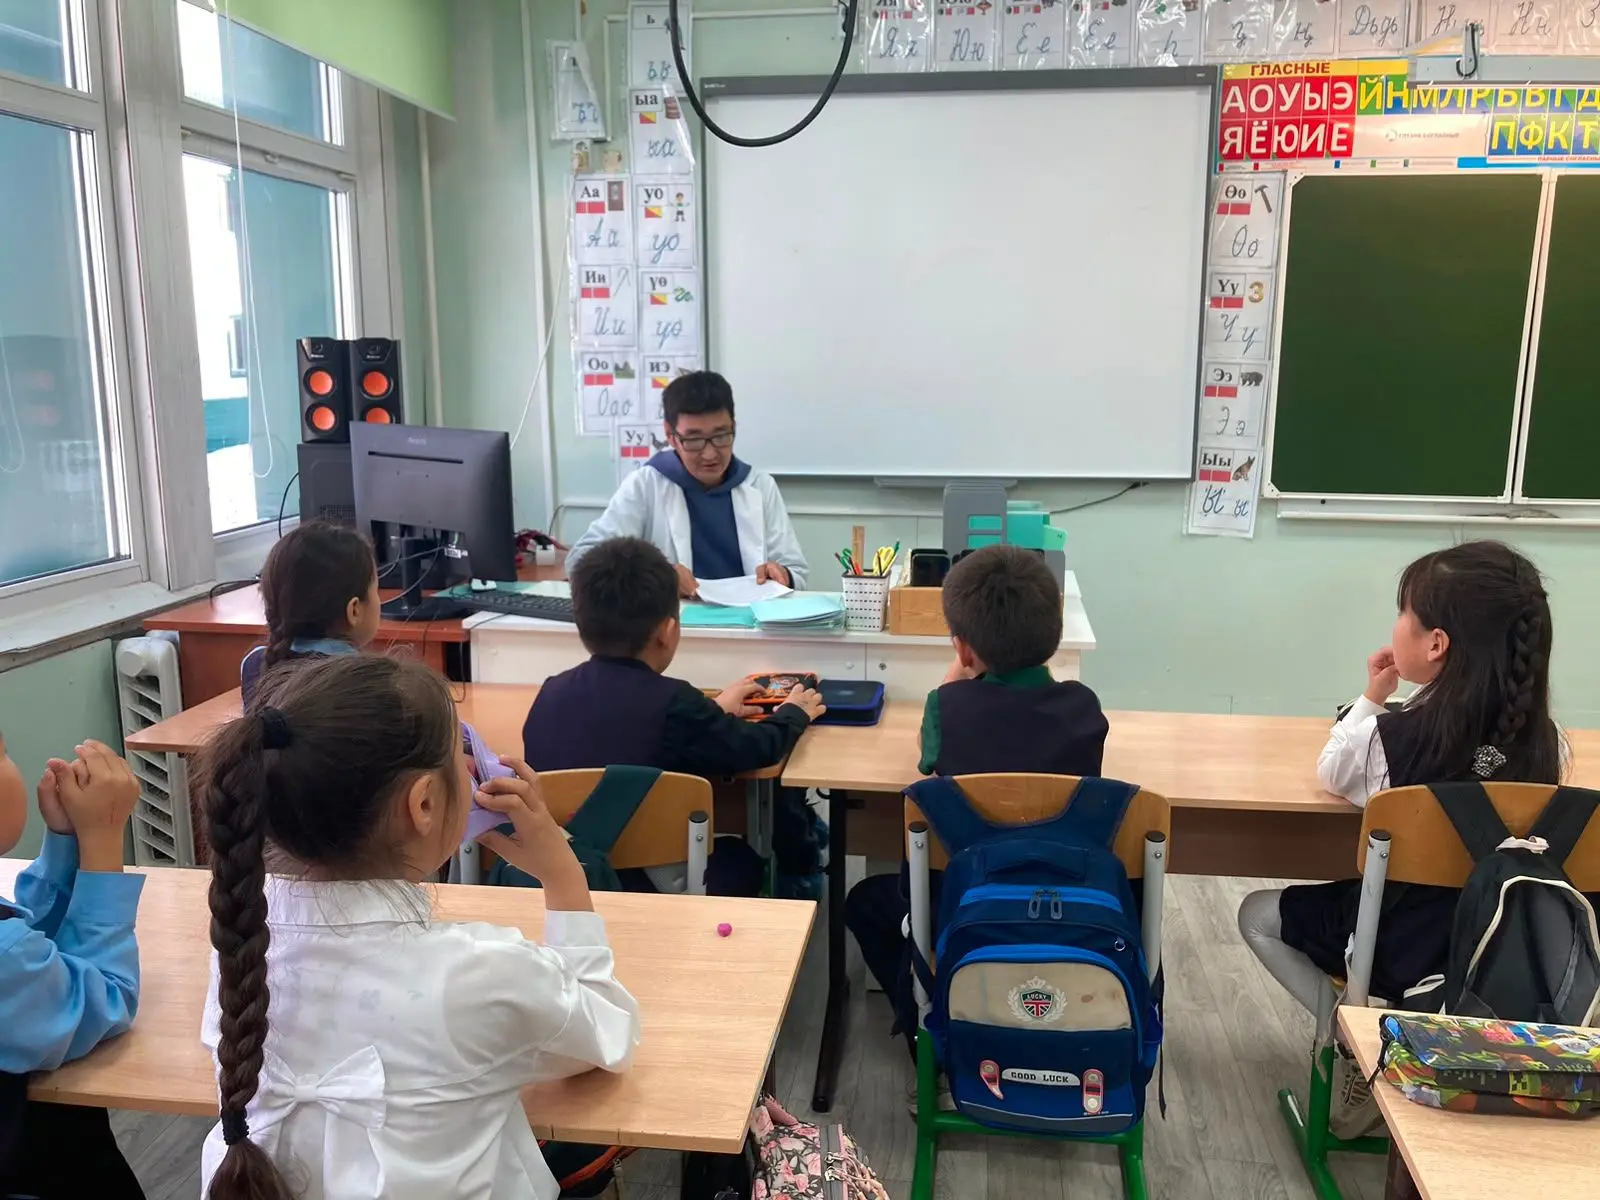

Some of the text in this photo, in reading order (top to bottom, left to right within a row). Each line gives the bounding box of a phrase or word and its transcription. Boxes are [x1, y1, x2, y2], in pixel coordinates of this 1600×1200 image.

[1249, 63, 1330, 76] ГЛАСНЫЕ
[1010, 1071, 1069, 1083] GOOD LUCK
